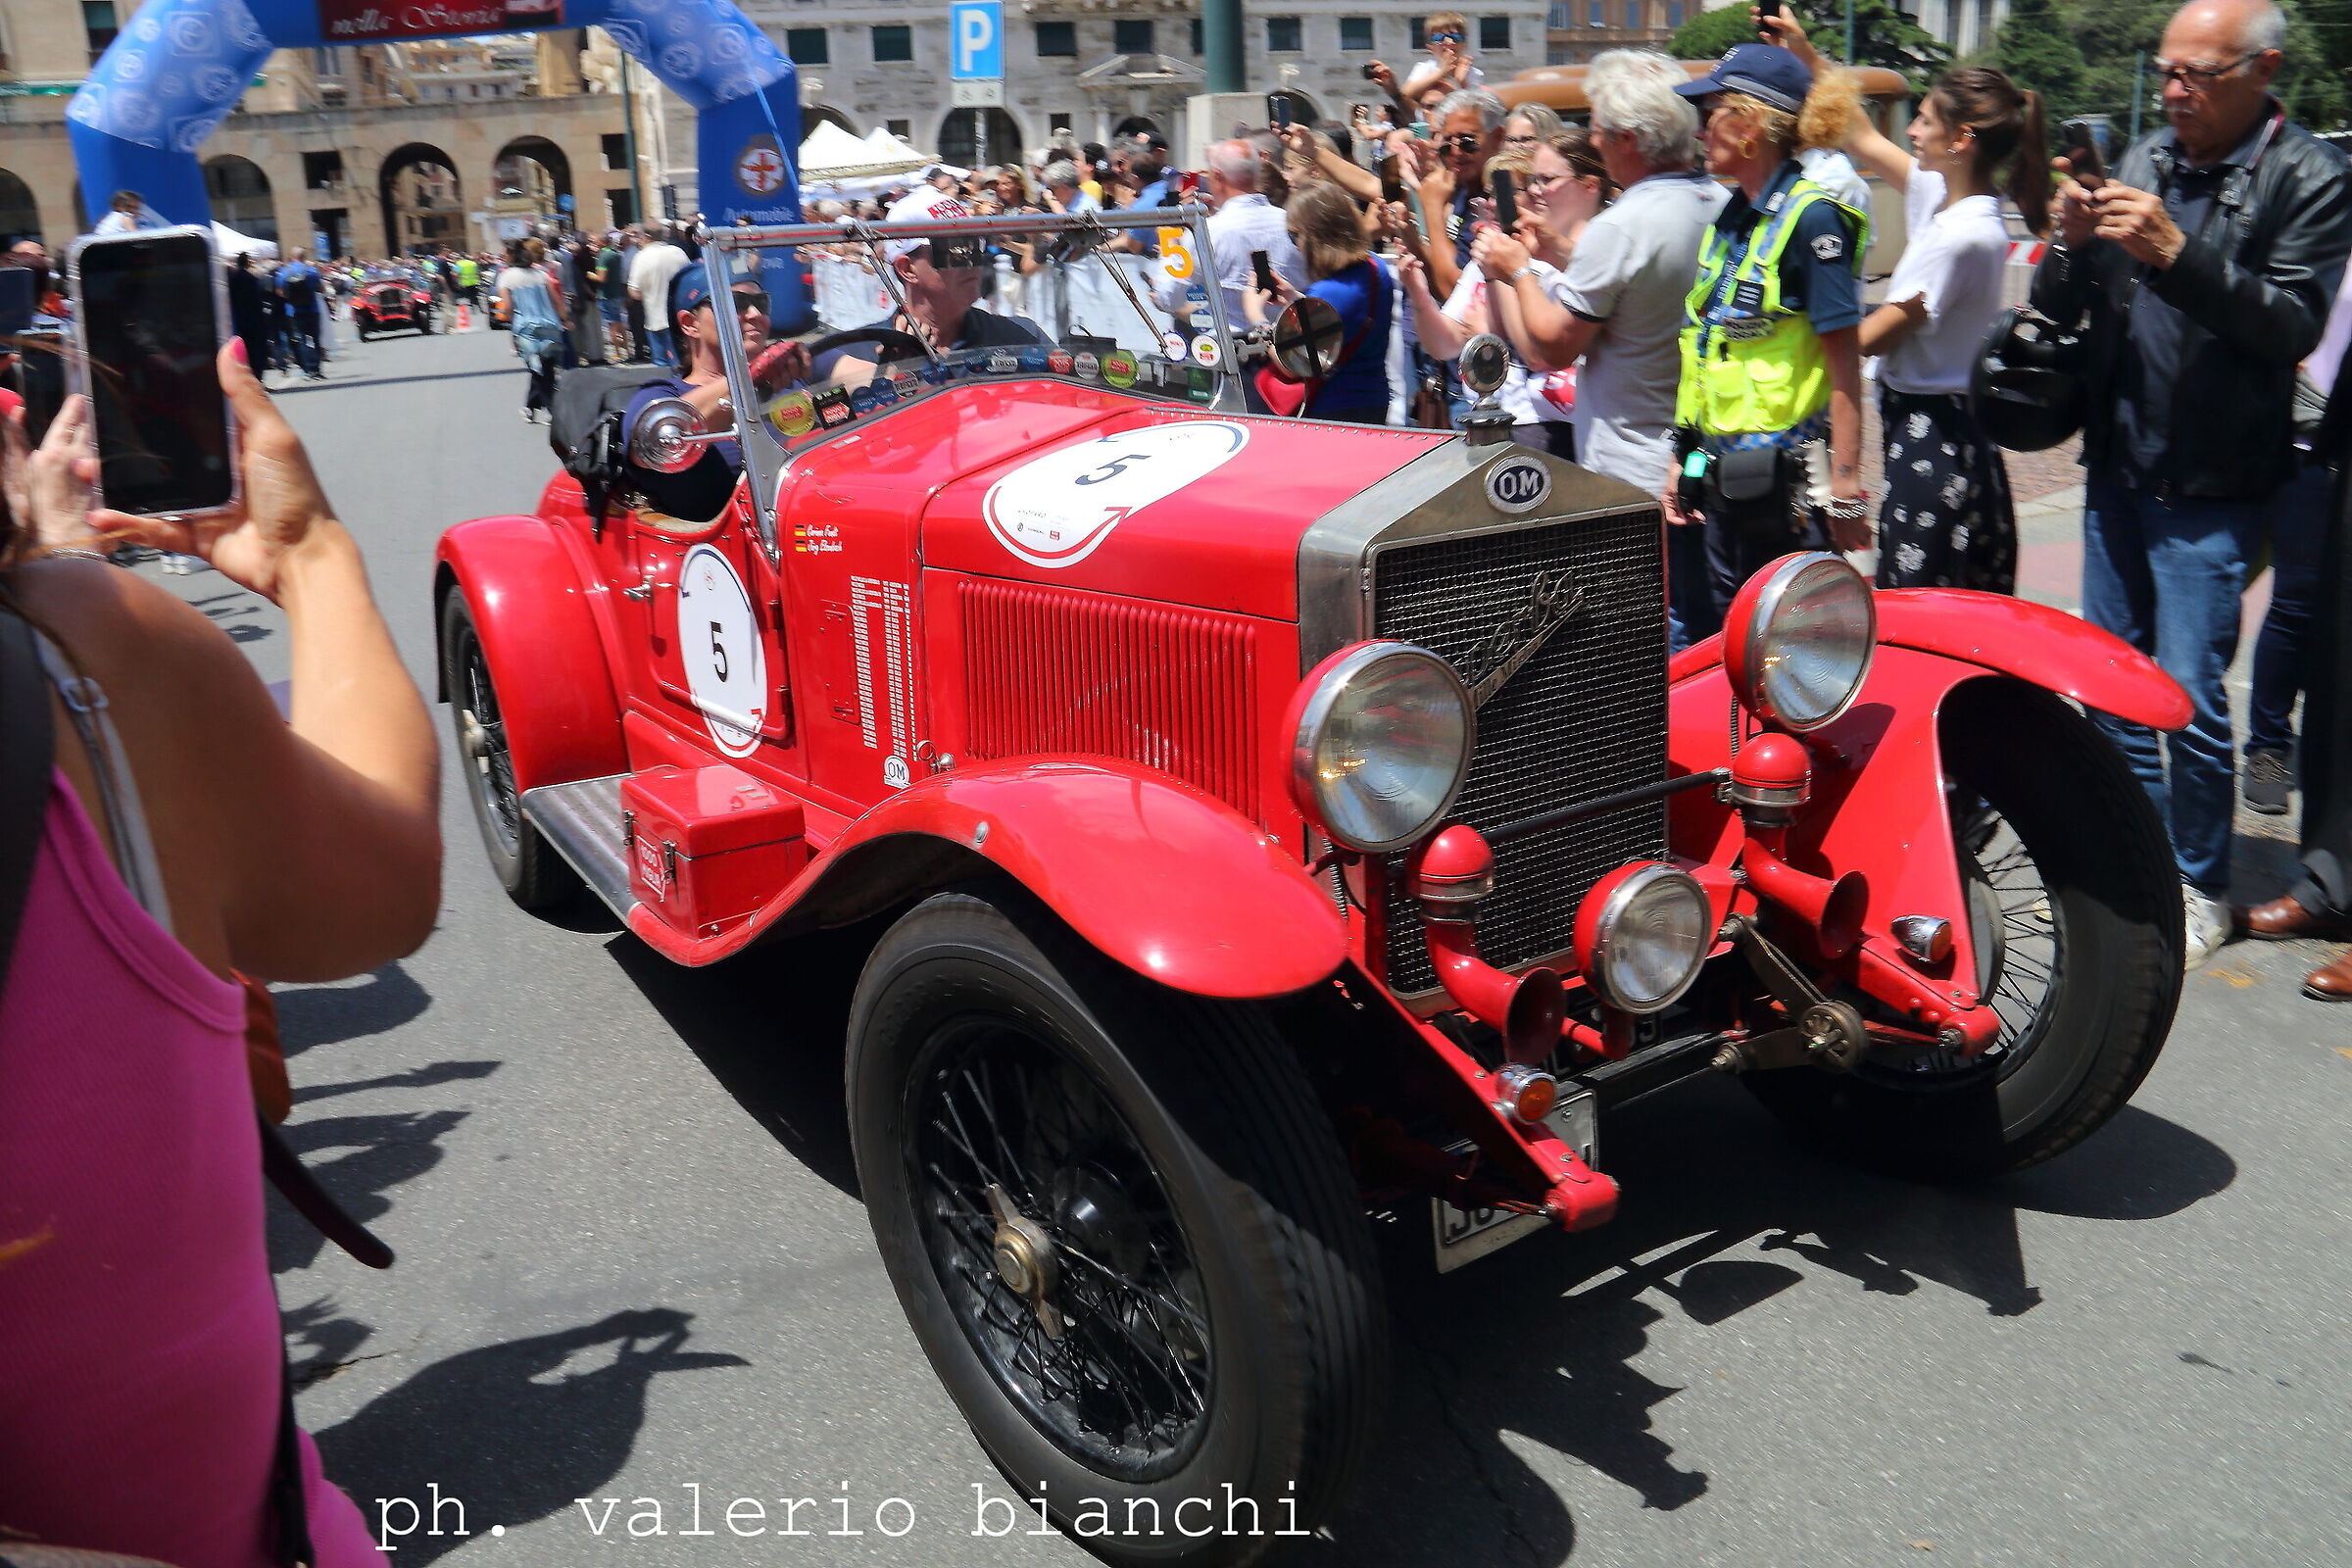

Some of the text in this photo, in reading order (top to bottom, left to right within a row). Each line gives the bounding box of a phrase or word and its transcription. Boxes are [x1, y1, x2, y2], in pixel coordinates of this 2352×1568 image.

[959, 9, 994, 72] P
[1155, 226, 1195, 278] 5
[1075, 455, 1152, 485] 5
[1498, 469, 1540, 500] OM
[710, 621, 728, 683] 5
[888, 761, 906, 781] OM
